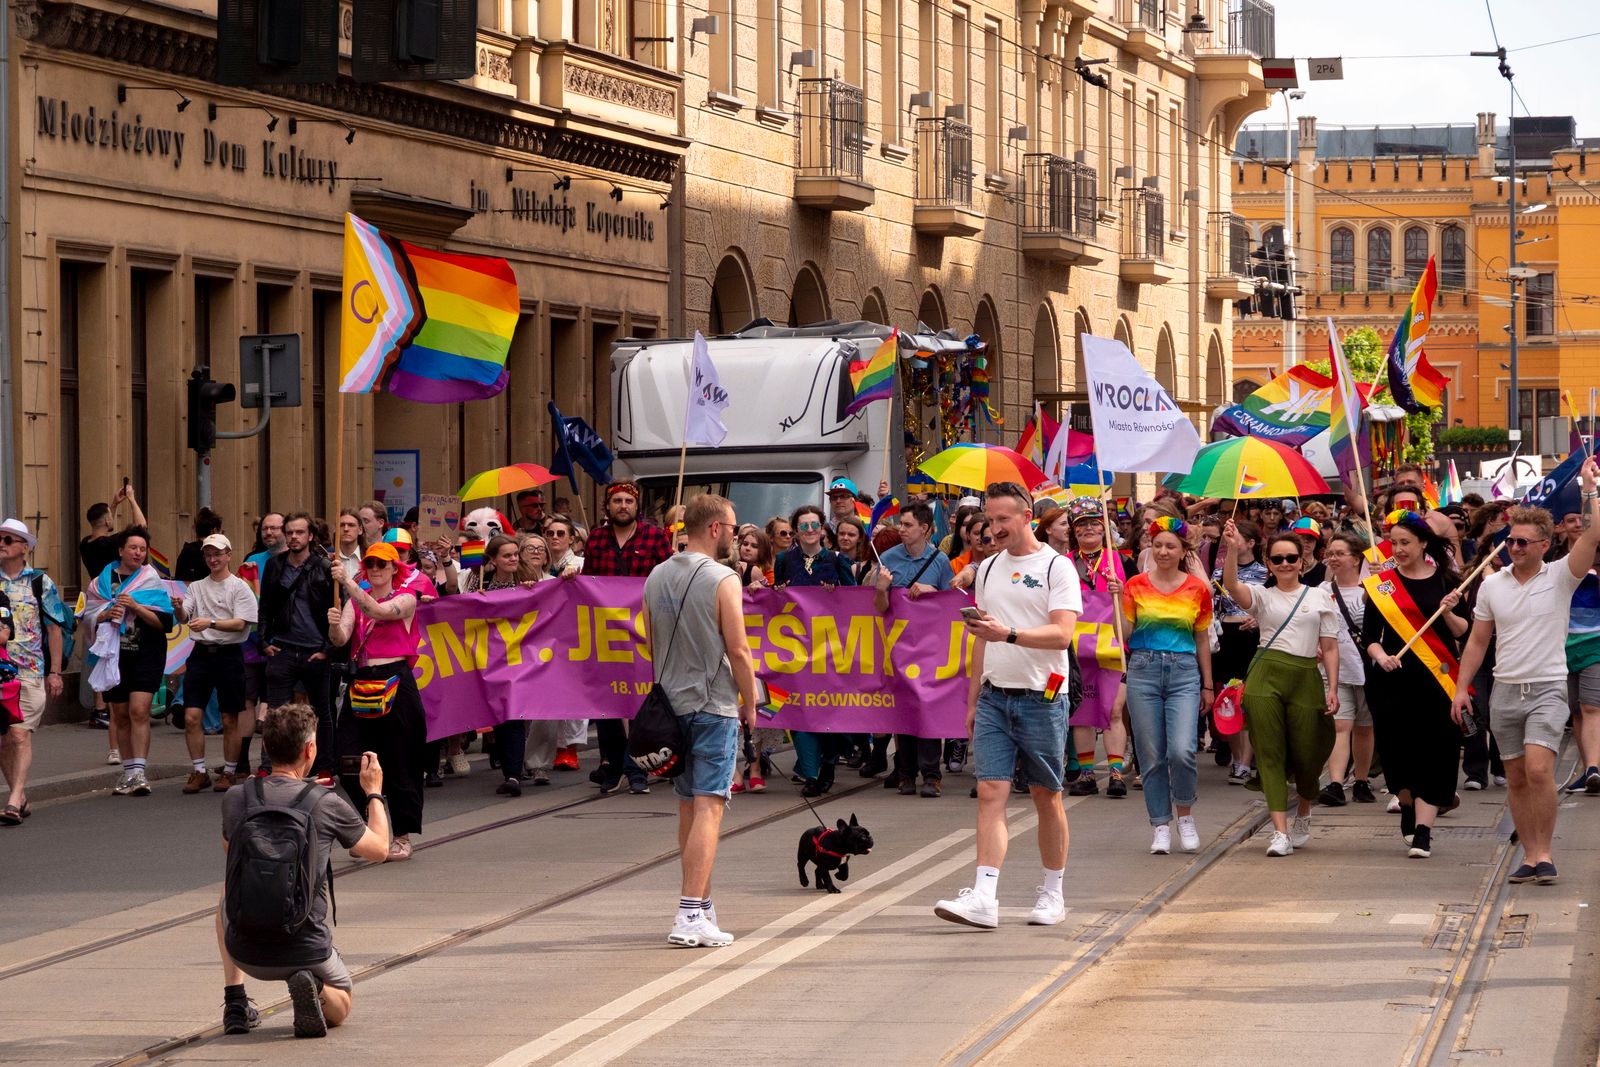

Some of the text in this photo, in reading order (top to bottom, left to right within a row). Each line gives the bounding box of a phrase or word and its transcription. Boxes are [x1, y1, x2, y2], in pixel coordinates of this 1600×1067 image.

[1316, 65, 1335, 74] 2P6
[37, 95, 338, 194] Młodzieżowy Dom Kultury
[586, 201, 655, 243] Kopernika
[1108, 419, 1133, 432] Miasto
[1133, 419, 1175, 433] Równości
[609, 680, 632, 695] 18.
[804, 690, 896, 708] RÓWNOŚCI
